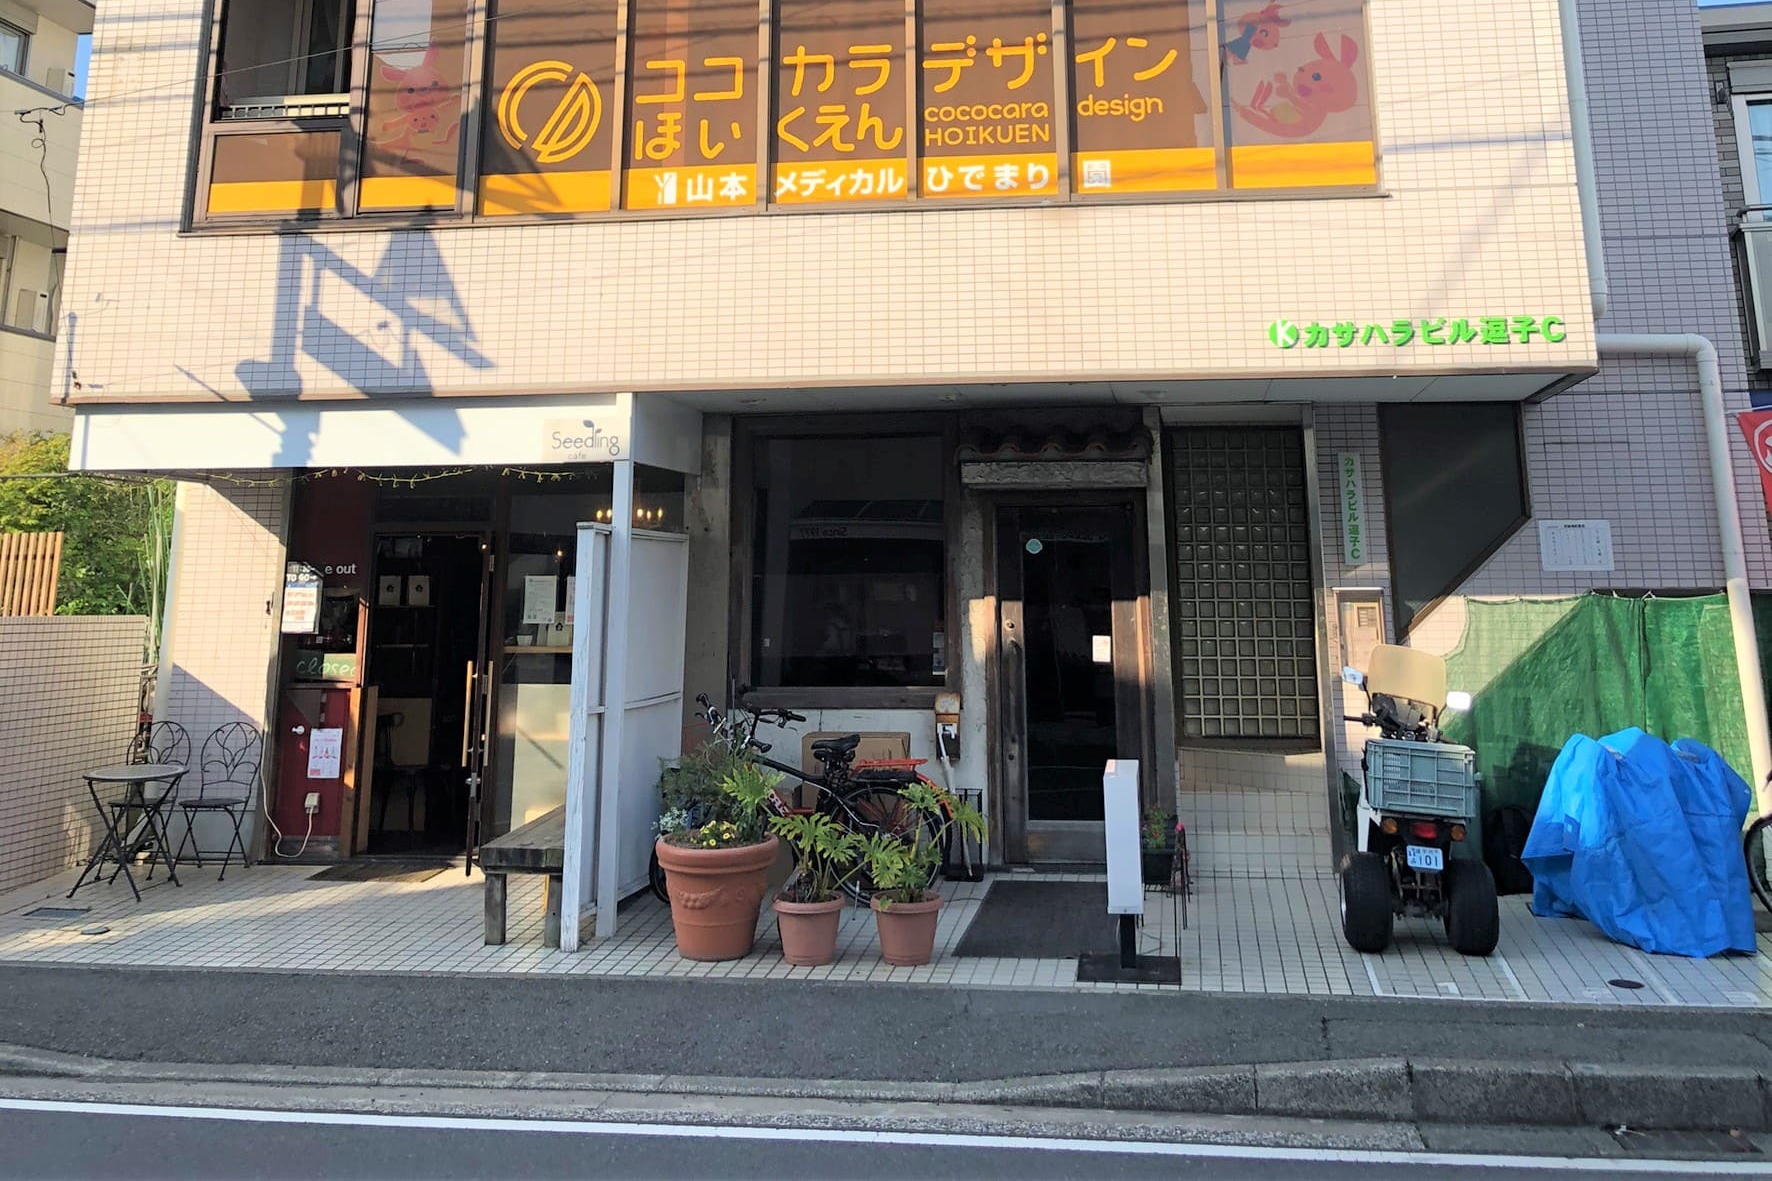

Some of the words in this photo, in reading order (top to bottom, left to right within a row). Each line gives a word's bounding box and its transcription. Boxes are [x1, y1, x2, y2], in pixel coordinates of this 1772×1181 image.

[635, 32, 1178, 103] ココカラデザイン
[924, 101, 1049, 122] cococara
[1077, 94, 1163, 122] design
[634, 103, 904, 160] ほいくえん
[924, 123, 1050, 147] HOIKUEN
[1303, 315, 1566, 348] カサハラビル逗子C
[1344, 457, 1361, 560] カサハラビル逗子C
[336, 563, 357, 574] out
